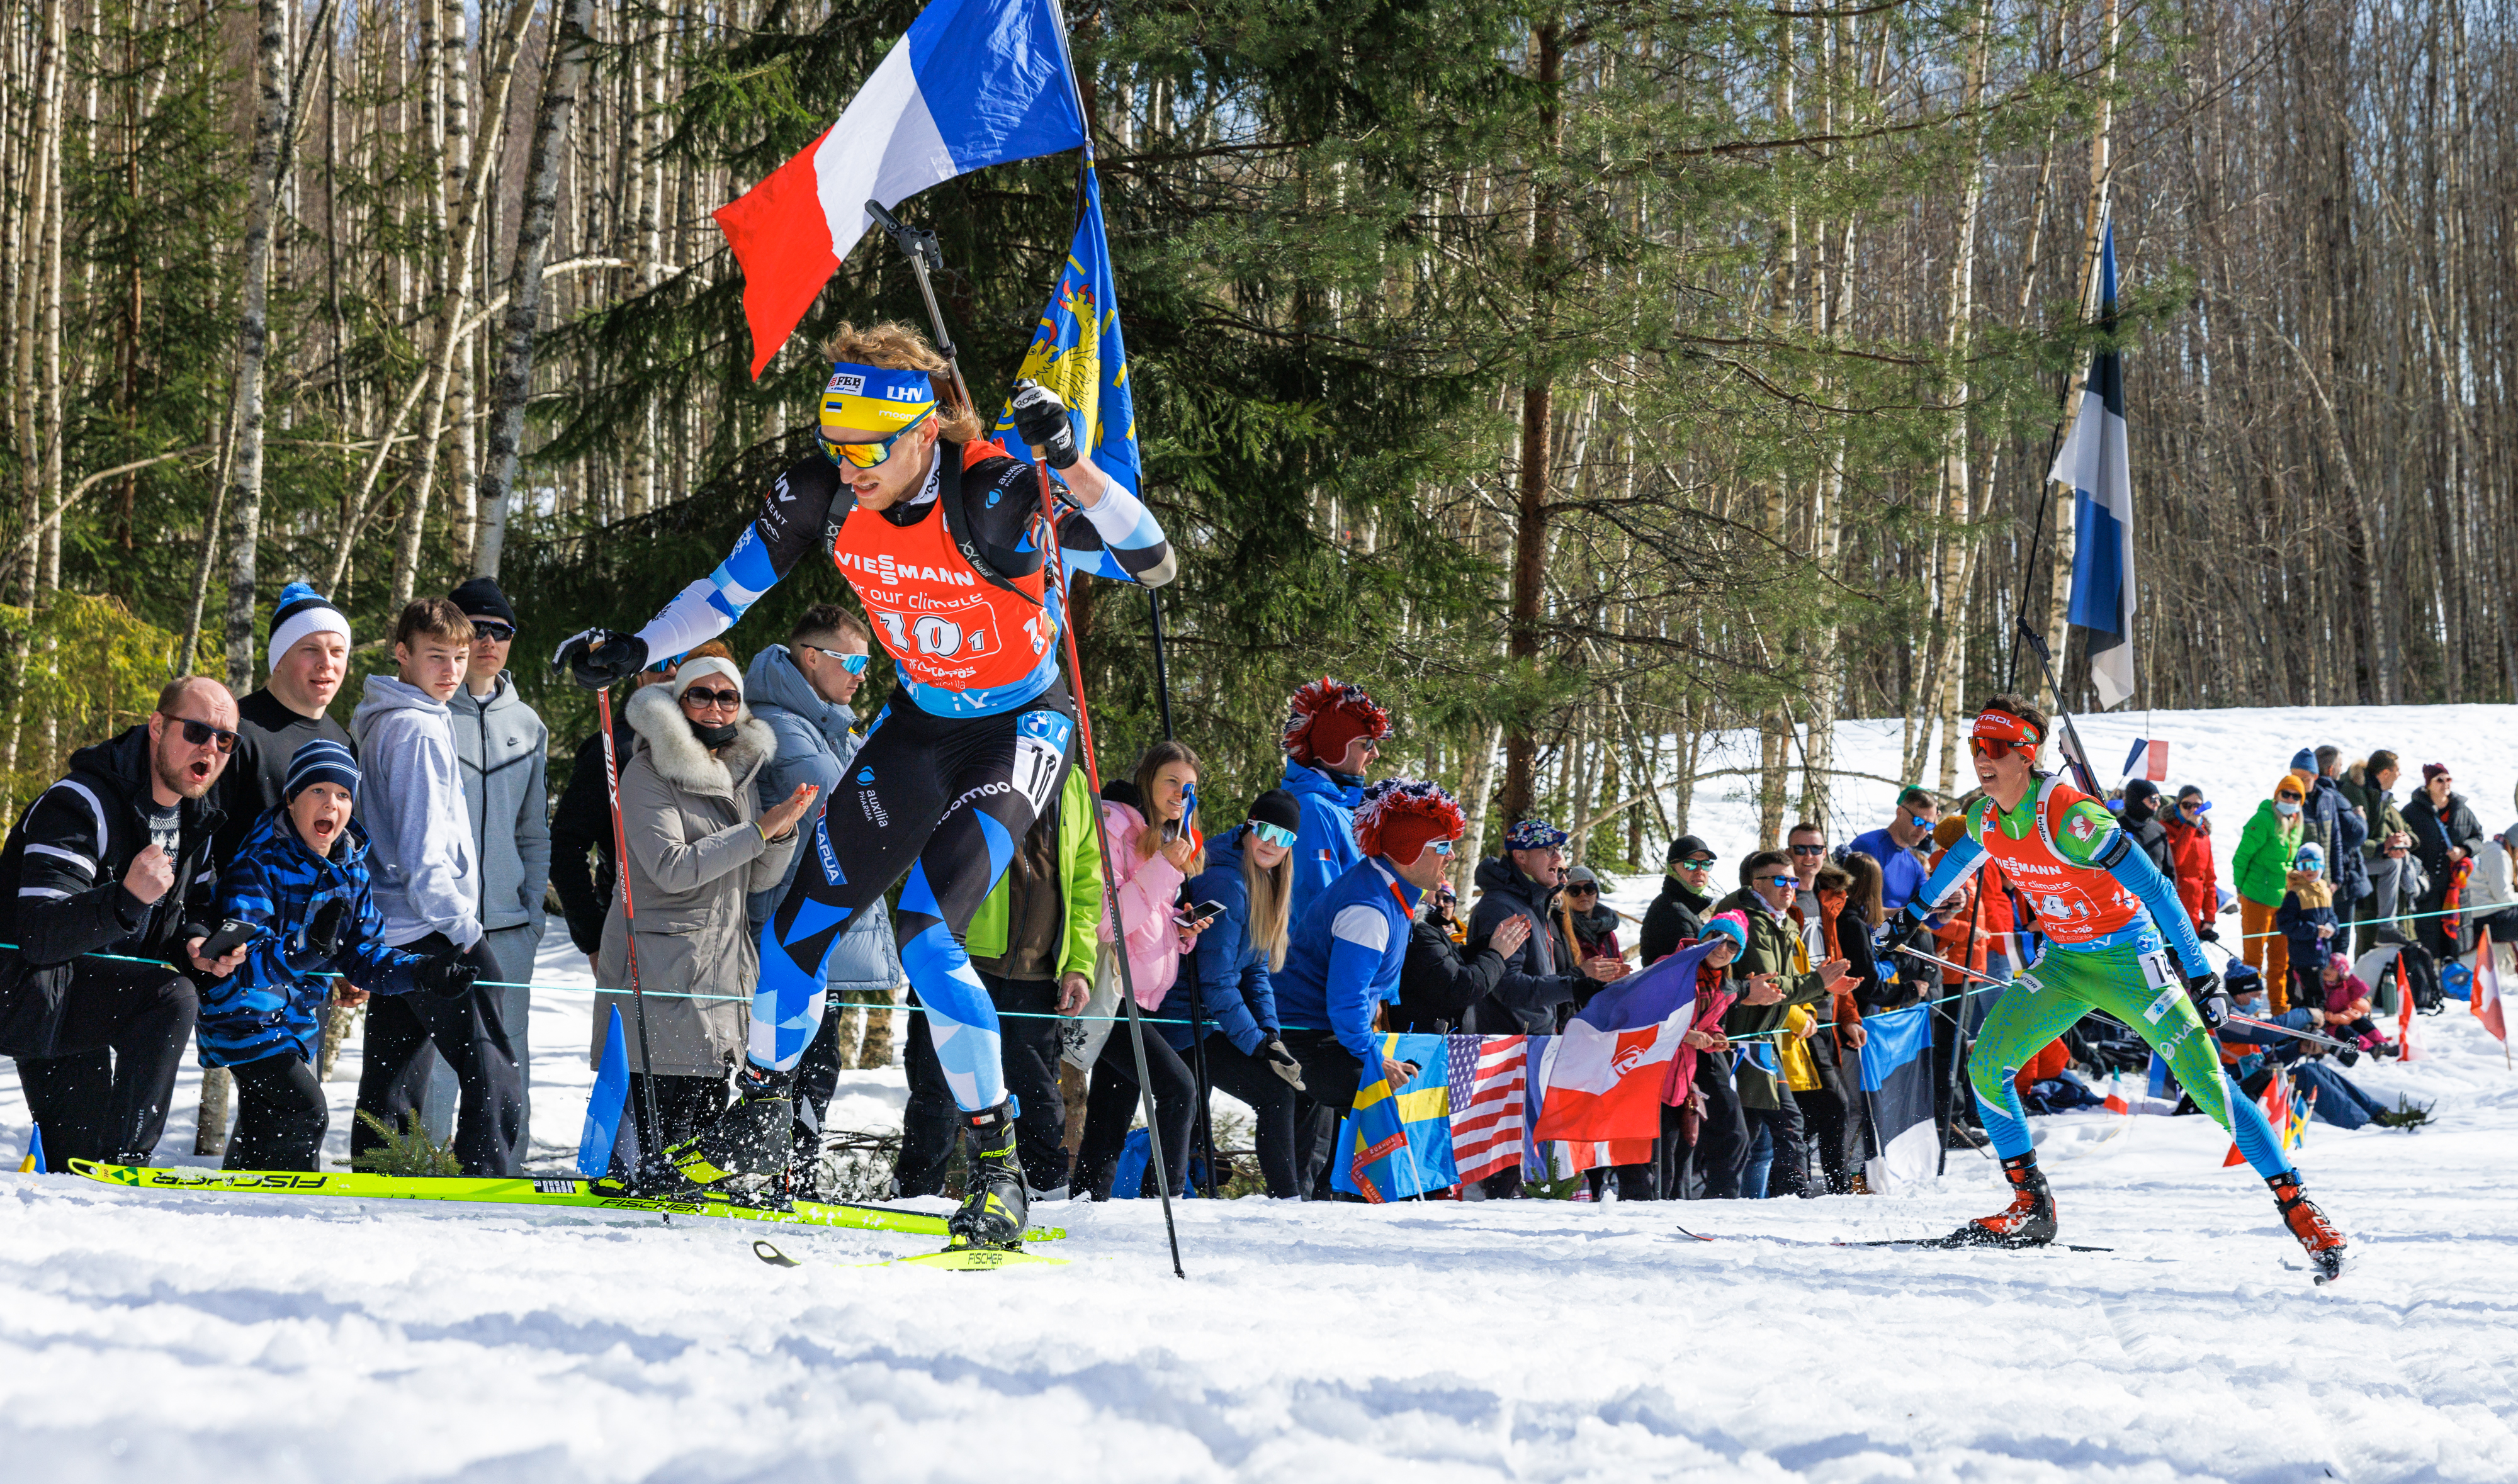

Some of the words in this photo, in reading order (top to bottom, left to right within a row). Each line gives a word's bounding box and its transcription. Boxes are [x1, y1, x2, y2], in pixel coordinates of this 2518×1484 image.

[836, 376, 862, 386] FEB
[835, 550, 975, 585] VIESSMANN
[972, 559, 993, 578] biatar
[870, 589, 903, 604] our
[874, 611, 963, 658] 10
[1076, 708, 1084, 734] TRIAC
[1082, 745, 1090, 770] AERO
[602, 733, 619, 811] SWIX
[857, 790, 874, 822] PHARMA
[866, 789, 888, 828] auxilia
[1985, 797, 1996, 811] trig
[2037, 816, 2048, 843] triglav
[818, 822, 840, 882] LAPUA
[1995, 856, 2063, 877] VIESSMANN
[2028, 880, 2072, 891] climate
[2074, 899, 2090, 918] 1
[1109, 900, 1120, 946] TECHNOLOGY
[2177, 916, 2203, 967] SLOVENIA
[2149, 953, 2177, 984] 14
[2199, 978, 2215, 994] SWIX
[2171, 1011, 2199, 1045] HALTI
[599, 1198, 704, 1213] FISCHER
[1366, 1183, 1384, 1204] BAUHA
[968, 1252, 1003, 1266] FISCHER
